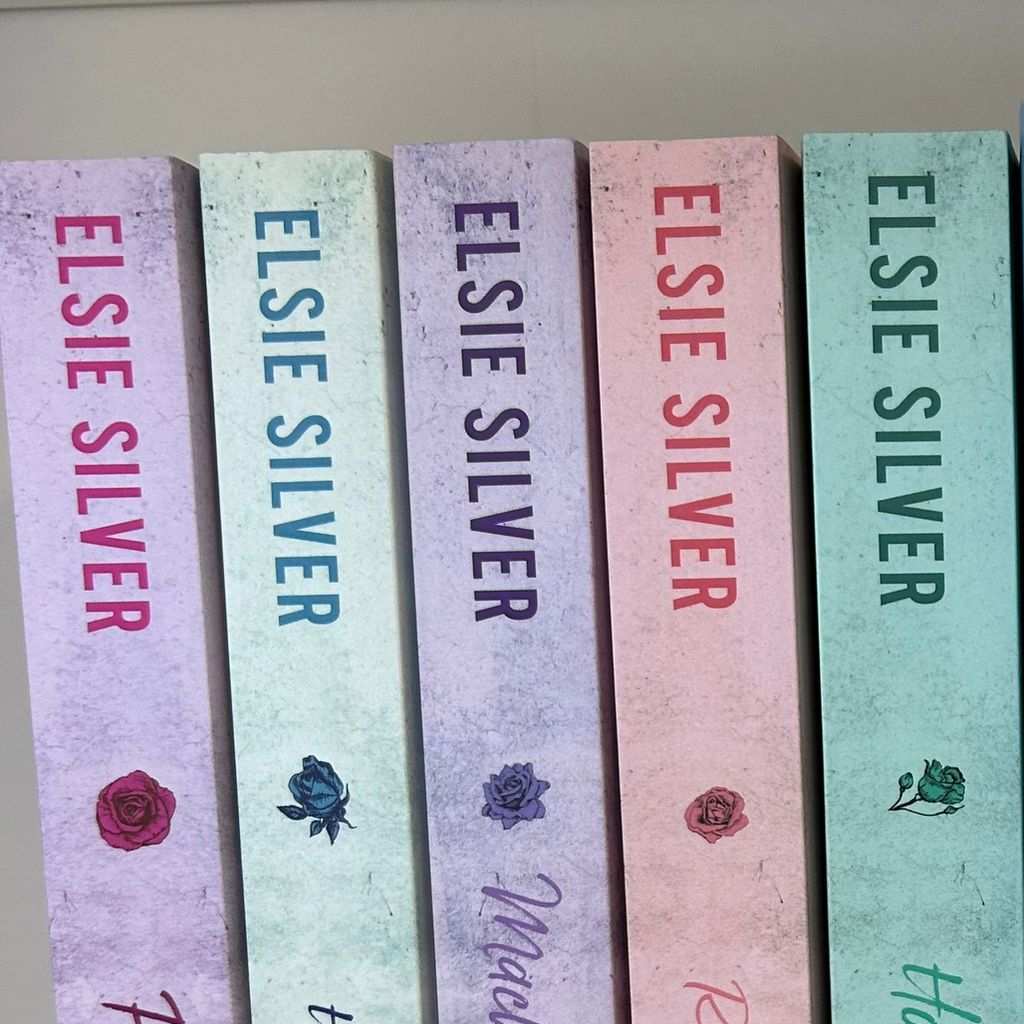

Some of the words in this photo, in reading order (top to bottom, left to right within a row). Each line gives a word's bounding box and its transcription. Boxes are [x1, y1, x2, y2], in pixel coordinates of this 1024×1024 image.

[55, 215, 134, 390] ELSIE
[254, 210, 328, 384] ELSIE
[454, 201, 526, 376] ELSIE
[653, 184, 728, 361] ELSIE
[867, 176, 939, 354] ELSIE
[71, 421, 151, 633] SILVER
[266, 415, 340, 626] SILVER
[464, 408, 538, 622] SILVER
[662, 394, 738, 611] SILVER
[874, 386, 945, 606] SILVER
